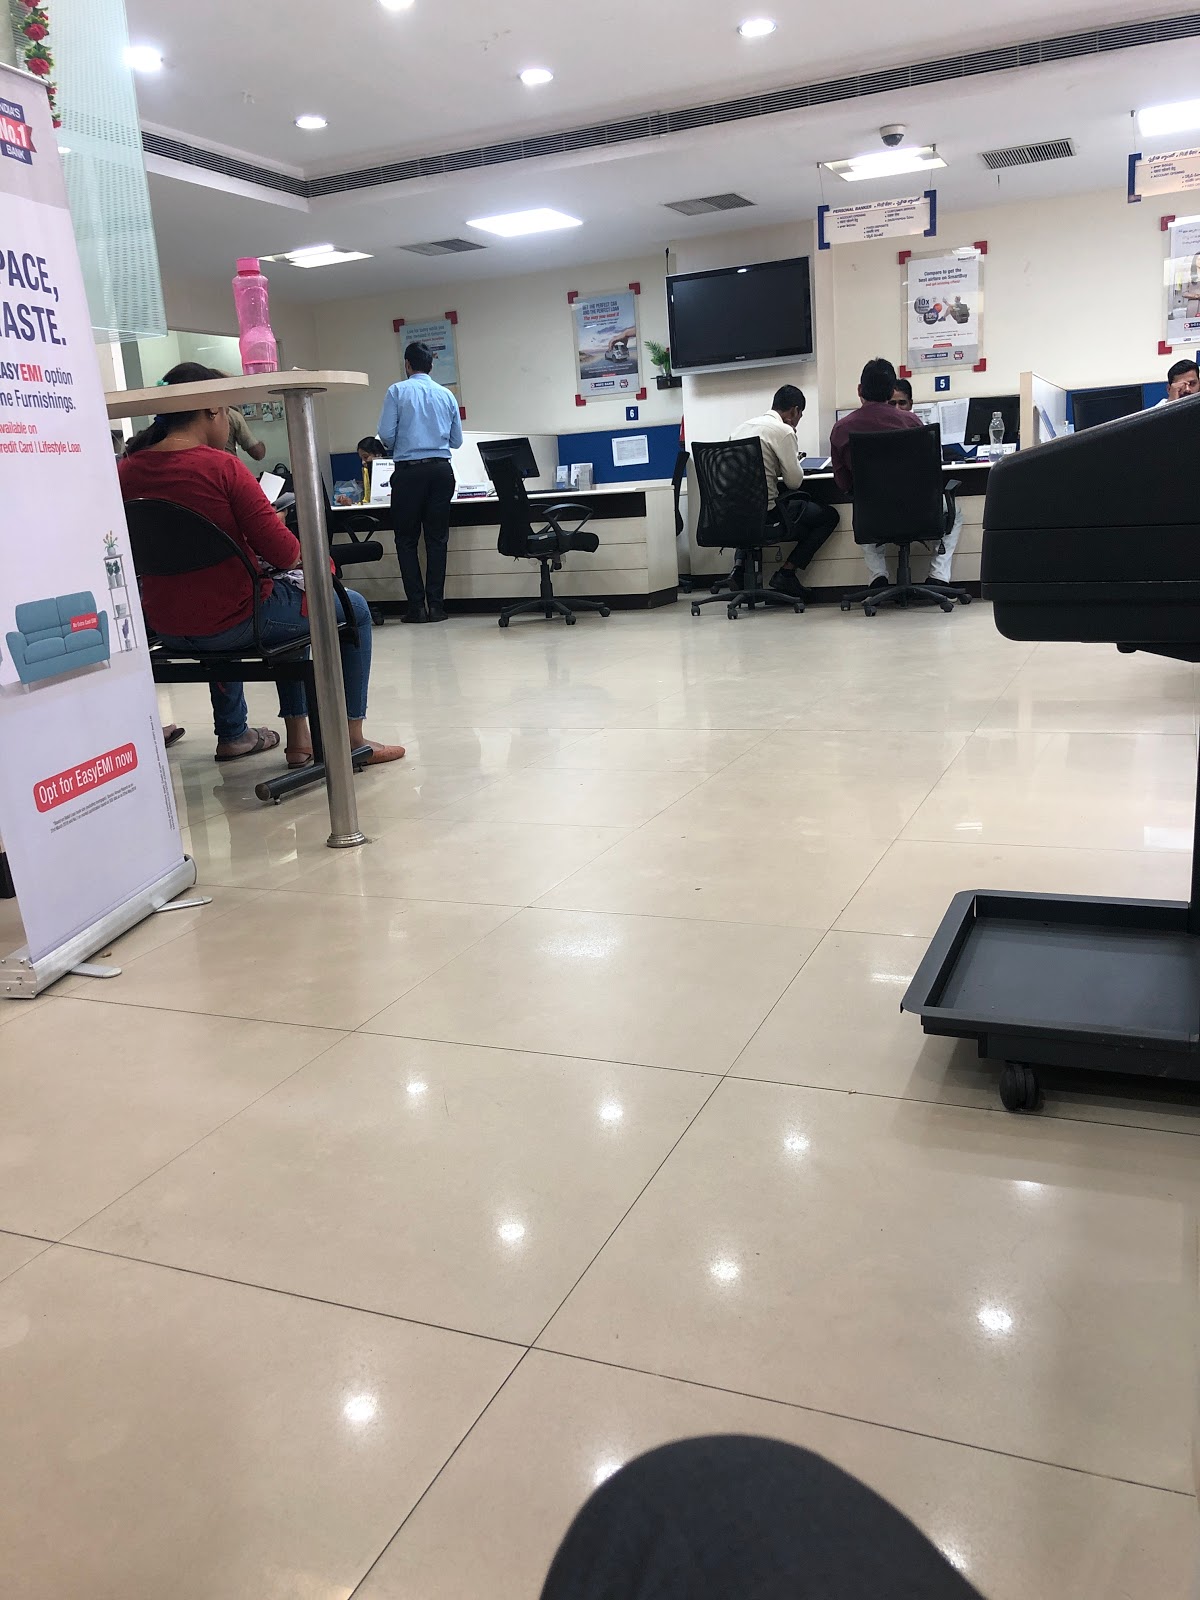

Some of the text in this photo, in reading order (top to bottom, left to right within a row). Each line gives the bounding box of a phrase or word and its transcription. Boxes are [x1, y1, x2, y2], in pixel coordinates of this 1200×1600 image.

[0, 103, 20, 118] NDIA'S
[0, 117, 27, 148] No.1
[5, 143, 27, 161] BANK
[0, 301, 67, 346] ASTE.
[0, 361, 74, 388] ASYEMI option
[939, 379, 946, 389] 5
[14, 389, 77, 414] Furnishings.
[629, 409, 635, 418] 6
[0, 421, 38, 435] vailable on
[0, 440, 18, 454] redit
[18, 440, 34, 454] Card
[38, 440, 67, 456] Lifestyle
[67, 441, 82, 453] Loan
[39, 750, 133, 805] Opt for EasyEMI now
